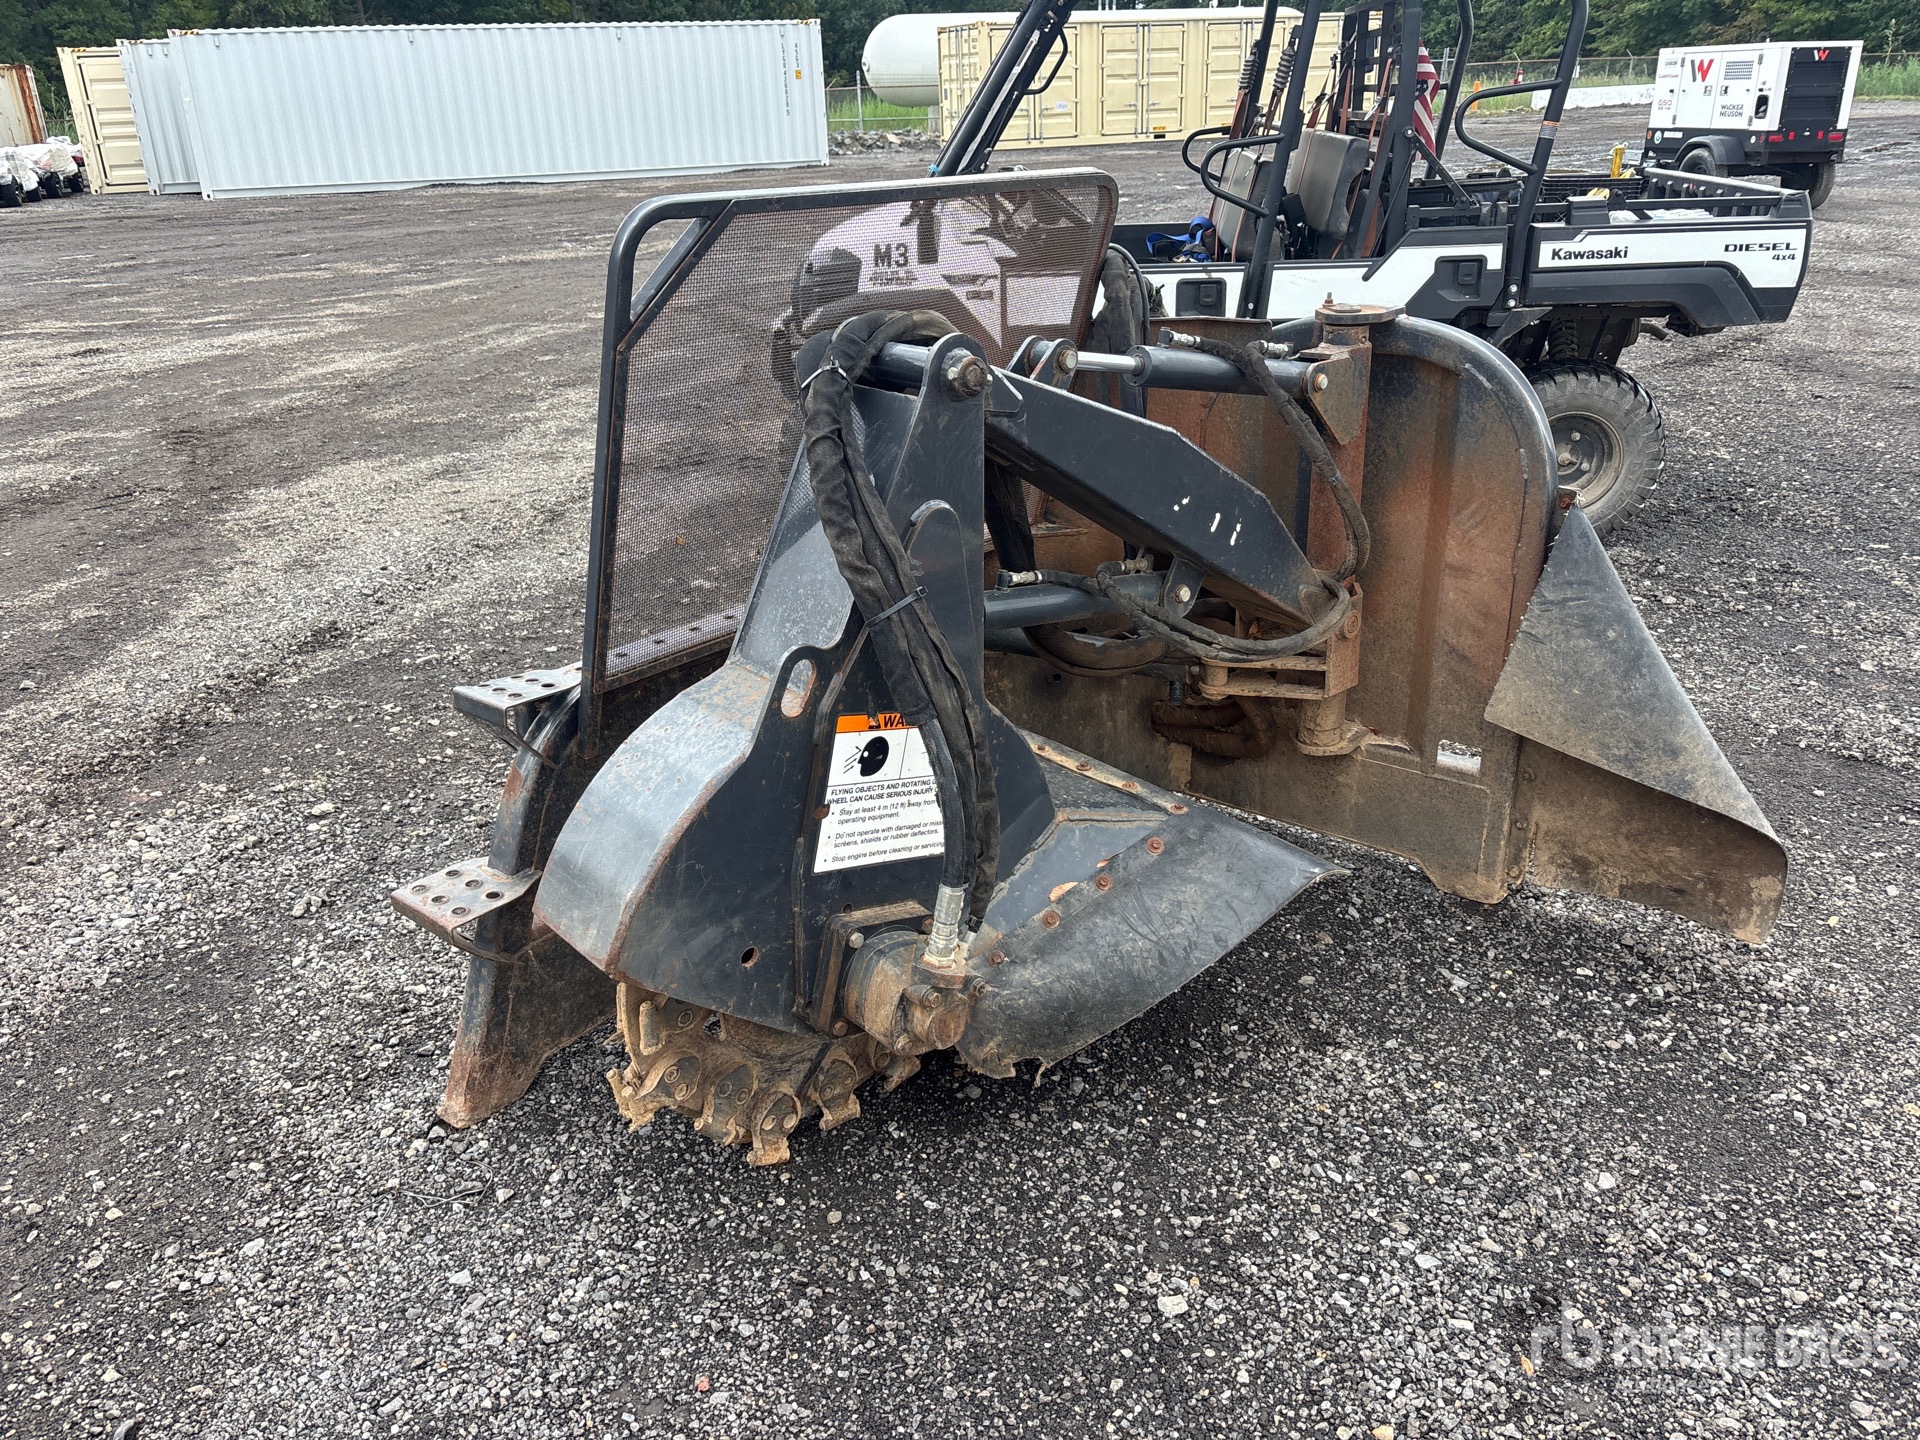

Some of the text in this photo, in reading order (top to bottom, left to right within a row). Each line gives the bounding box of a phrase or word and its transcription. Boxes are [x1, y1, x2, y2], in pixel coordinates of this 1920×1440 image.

[1551, 246, 1628, 260] Kawasaki
[1724, 242, 1798, 252] DIESEL
[874, 243, 908, 267] M3
[831, 788, 854, 796] FLYING
[854, 784, 884, 793] OBJECTS
[900, 780, 930, 788] ROTATING
[864, 792, 885, 801] CAUSE
[886, 790, 912, 798] SERIOUS
[912, 787, 934, 795] INJURY
[840, 808, 853, 816] Stay
[862, 805, 876, 813] least
[890, 802, 900, 811] (12
[907, 800, 922, 808] away
[838, 816, 867, 825] operating
[856, 828, 880, 837] operate
[894, 822, 922, 831] damaged
[834, 840, 858, 848] screens,
[860, 836, 882, 844] shields
[847, 852, 868, 860] engine
[868, 849, 888, 857] before
[888, 846, 912, 854] cleaning
